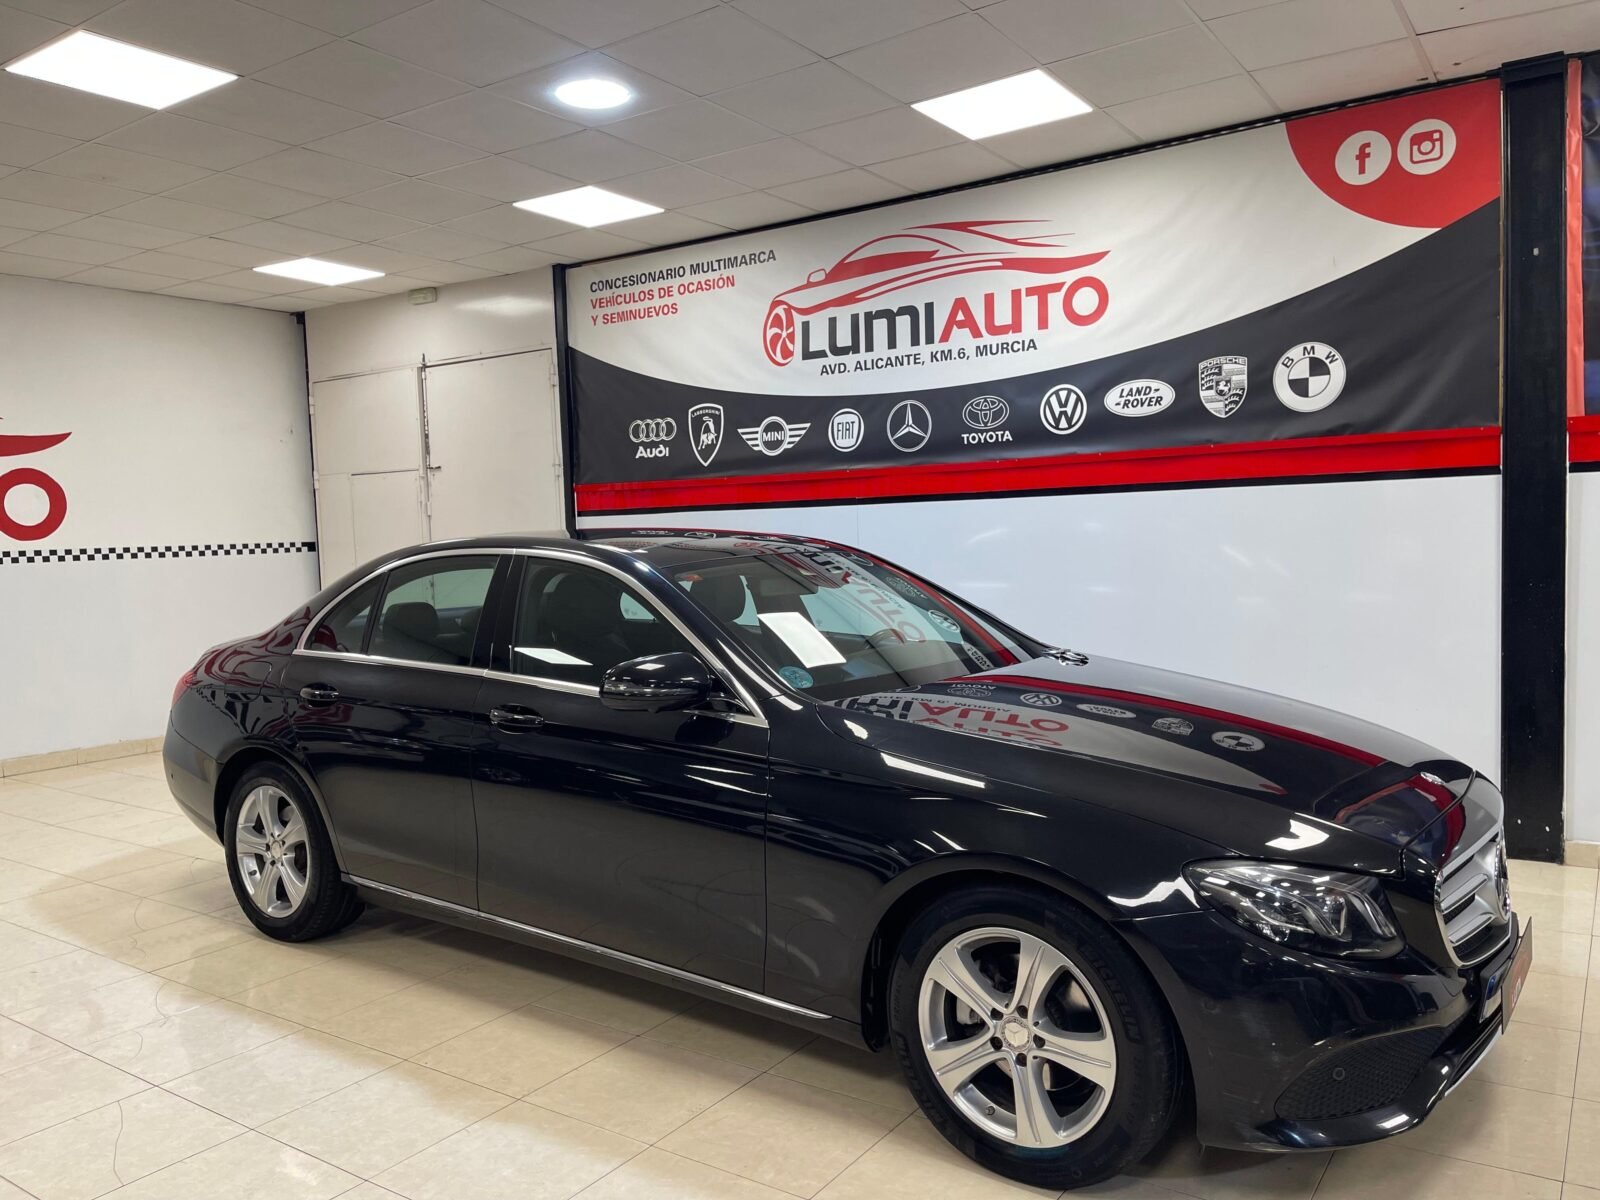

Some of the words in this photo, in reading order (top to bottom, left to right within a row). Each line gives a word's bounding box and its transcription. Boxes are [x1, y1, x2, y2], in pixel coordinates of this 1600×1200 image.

[590, 265, 686, 293] CONCESIONARIO
[690, 249, 776, 276] MULTIMARCA
[590, 289, 655, 310] VEHÍCULOS
[658, 286, 674, 300] DE
[677, 274, 736, 296] OCASIÓN
[591, 315, 599, 326] Y
[602, 303, 679, 325] SEMINUEVOS
[820, 361, 851, 376] AVD.
[854, 353, 926, 373] ALICANTE,
[930, 347, 971, 364] KM.6,
[975, 338, 1038, 358] MURCIA
[1281, 345, 1340, 370] BMW
[762, 430, 785, 442] MINI
[835, 419, 857, 441] FIAT
[961, 430, 1013, 445] TOYOTA
[635, 445, 669, 459] Audi
